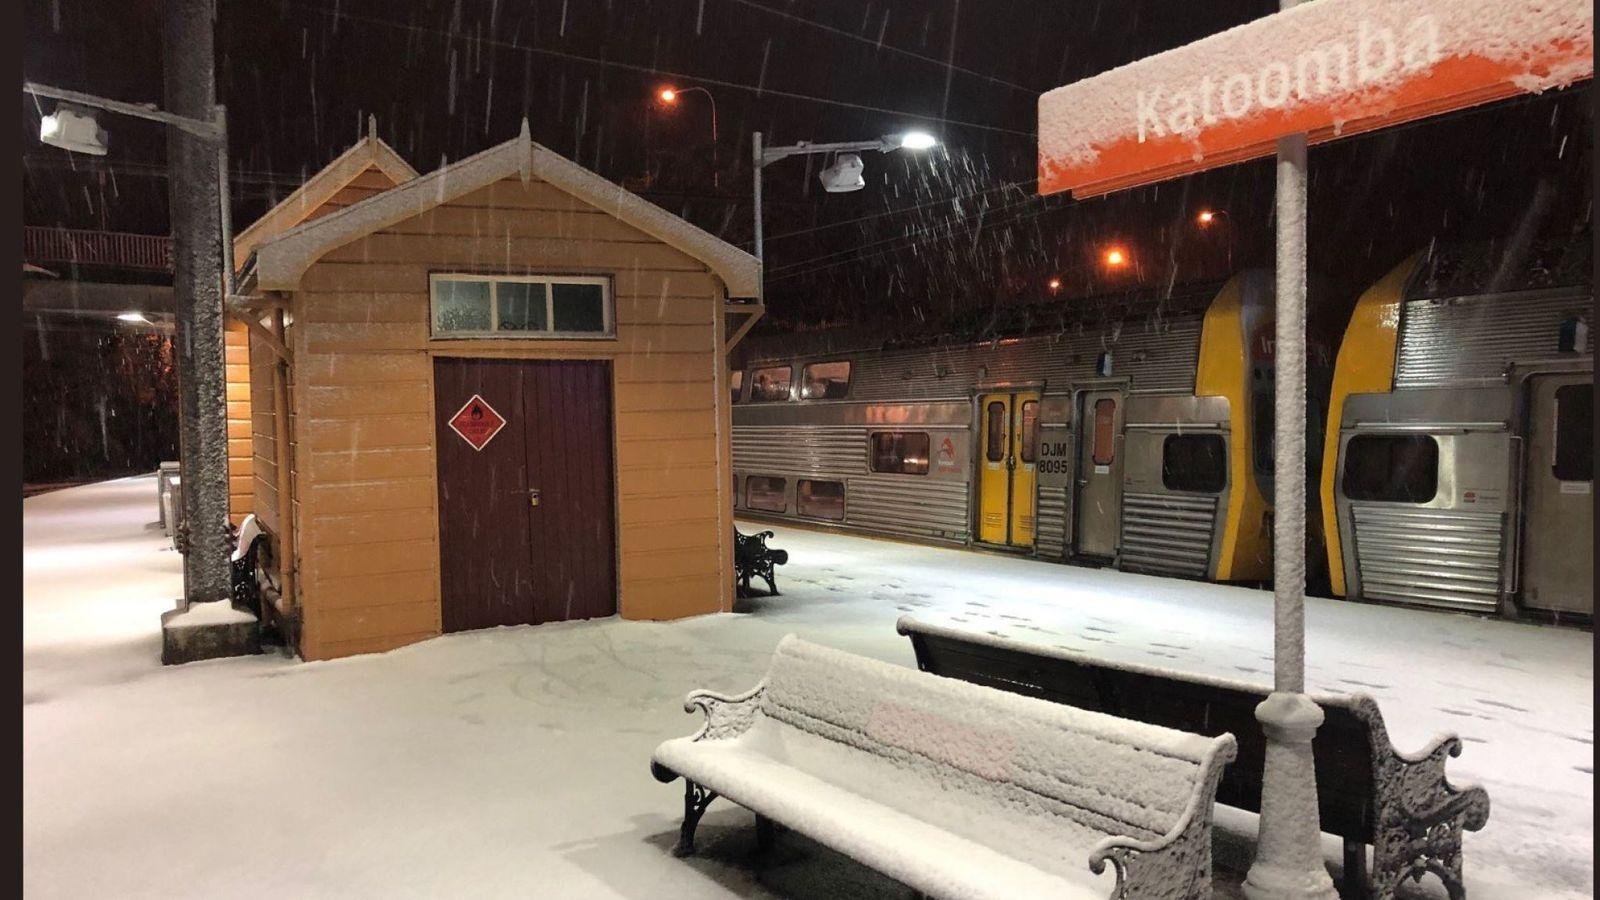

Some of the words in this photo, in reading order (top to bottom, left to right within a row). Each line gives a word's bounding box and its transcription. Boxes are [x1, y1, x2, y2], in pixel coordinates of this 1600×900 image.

[1135, 14, 1442, 143] Katoomba
[1041, 442, 1067, 457] DJM
[1039, 459, 1068, 474] 8095
